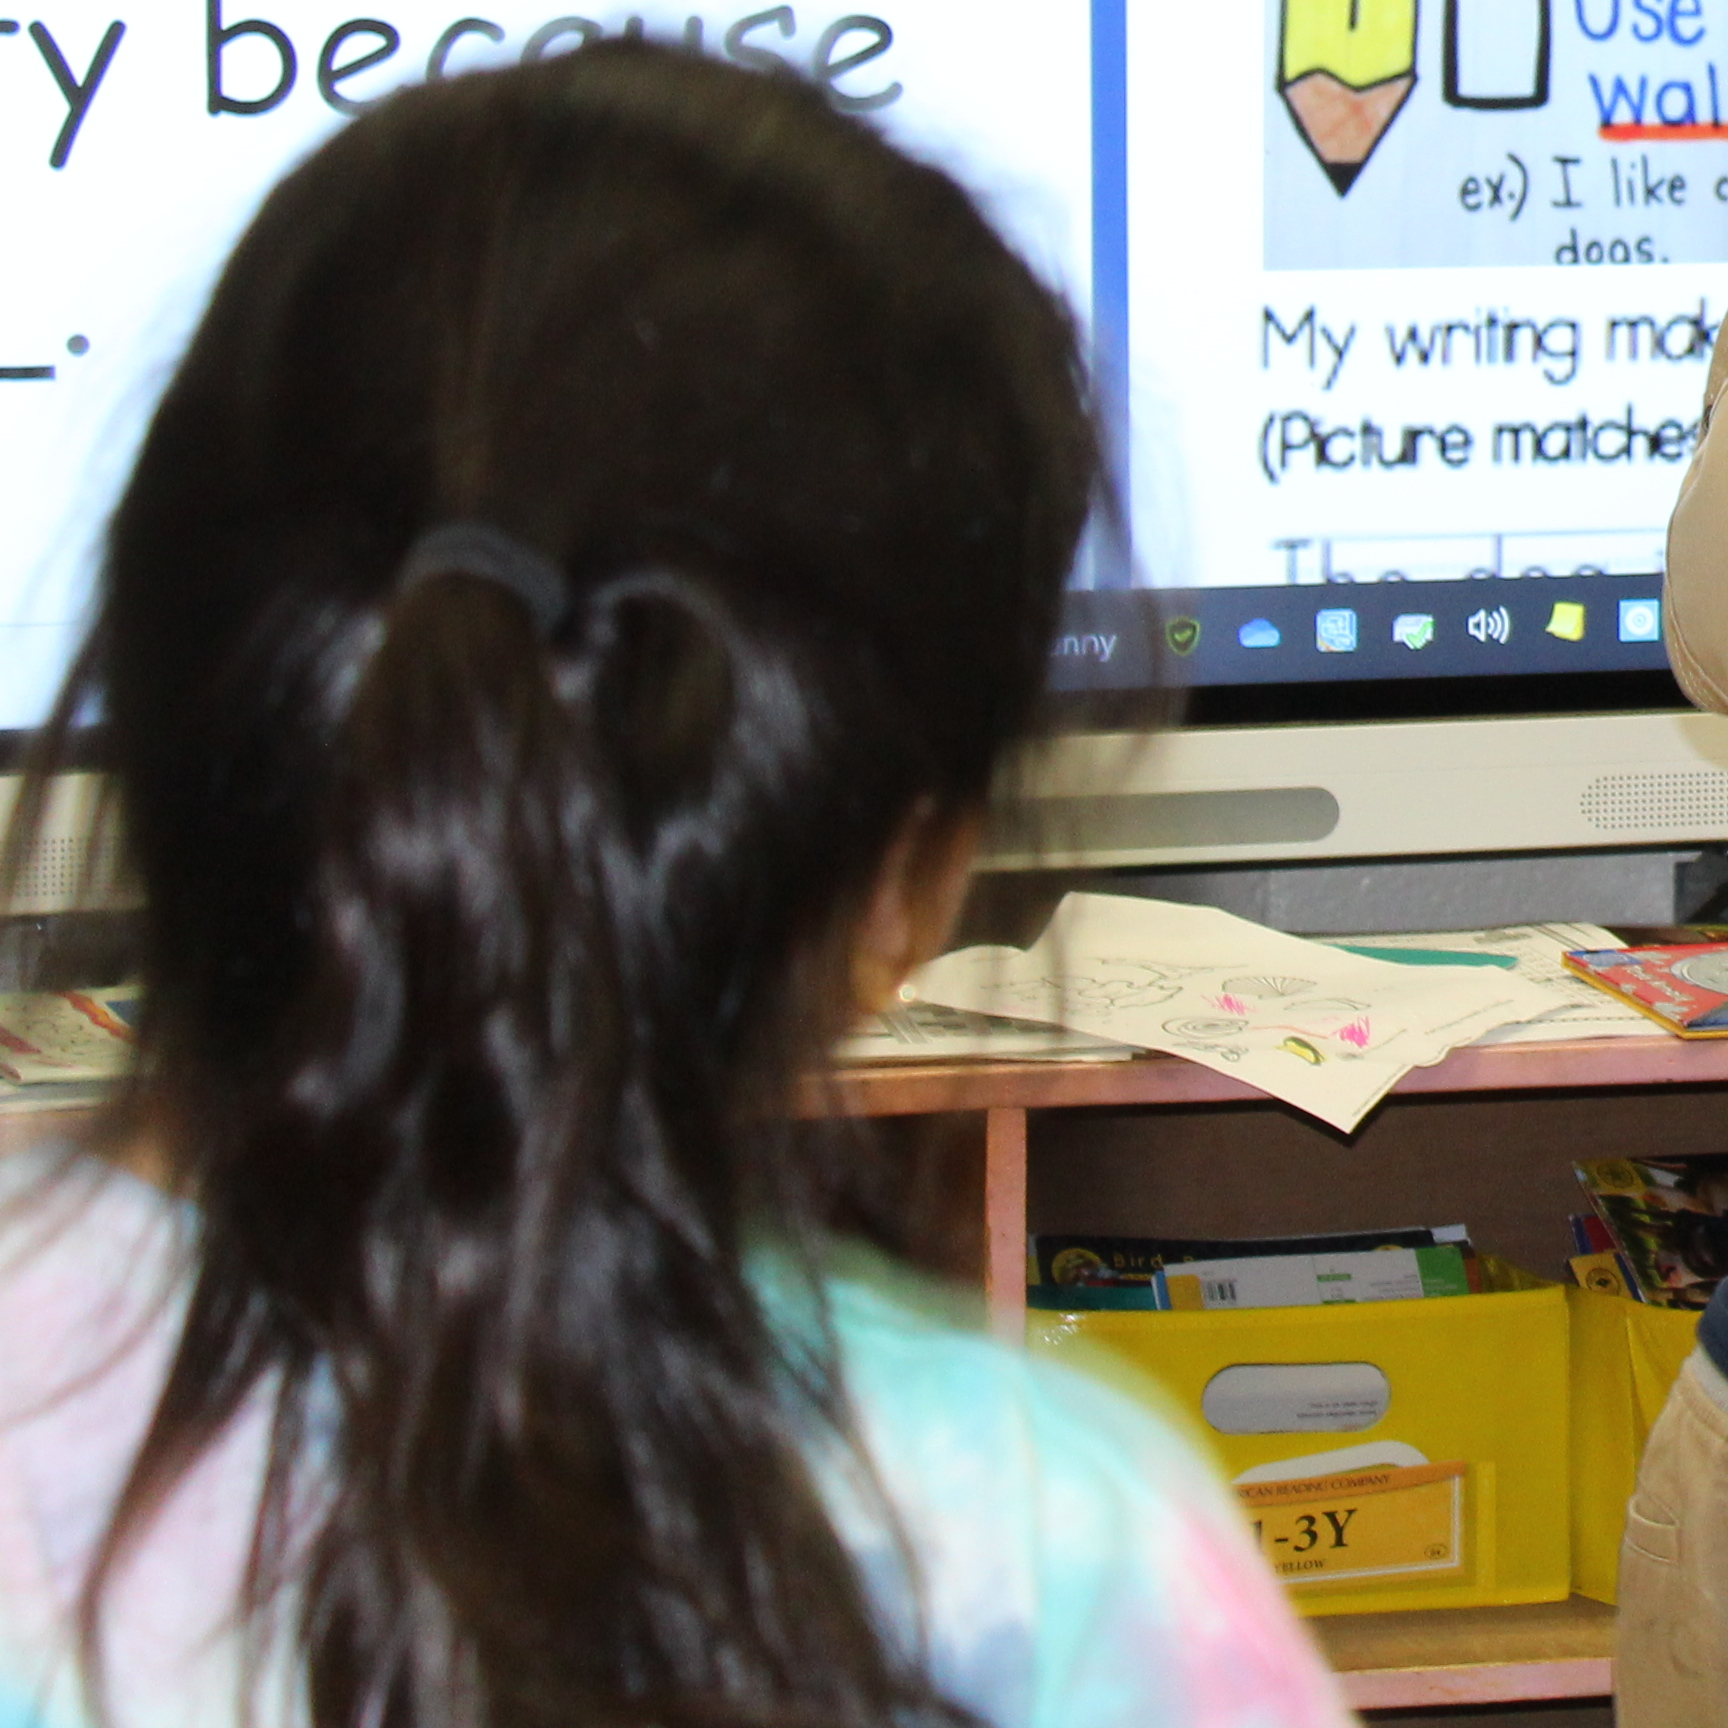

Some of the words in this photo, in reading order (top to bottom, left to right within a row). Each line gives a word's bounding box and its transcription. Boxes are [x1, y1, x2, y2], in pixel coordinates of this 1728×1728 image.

[1550, 156, 1583, 210] I
[1611, 155, 1688, 207] like
[1261, 305, 1355, 389] My
[1389, 305, 1578, 383] writing
[1259, 413, 1471, 483] (Picture
